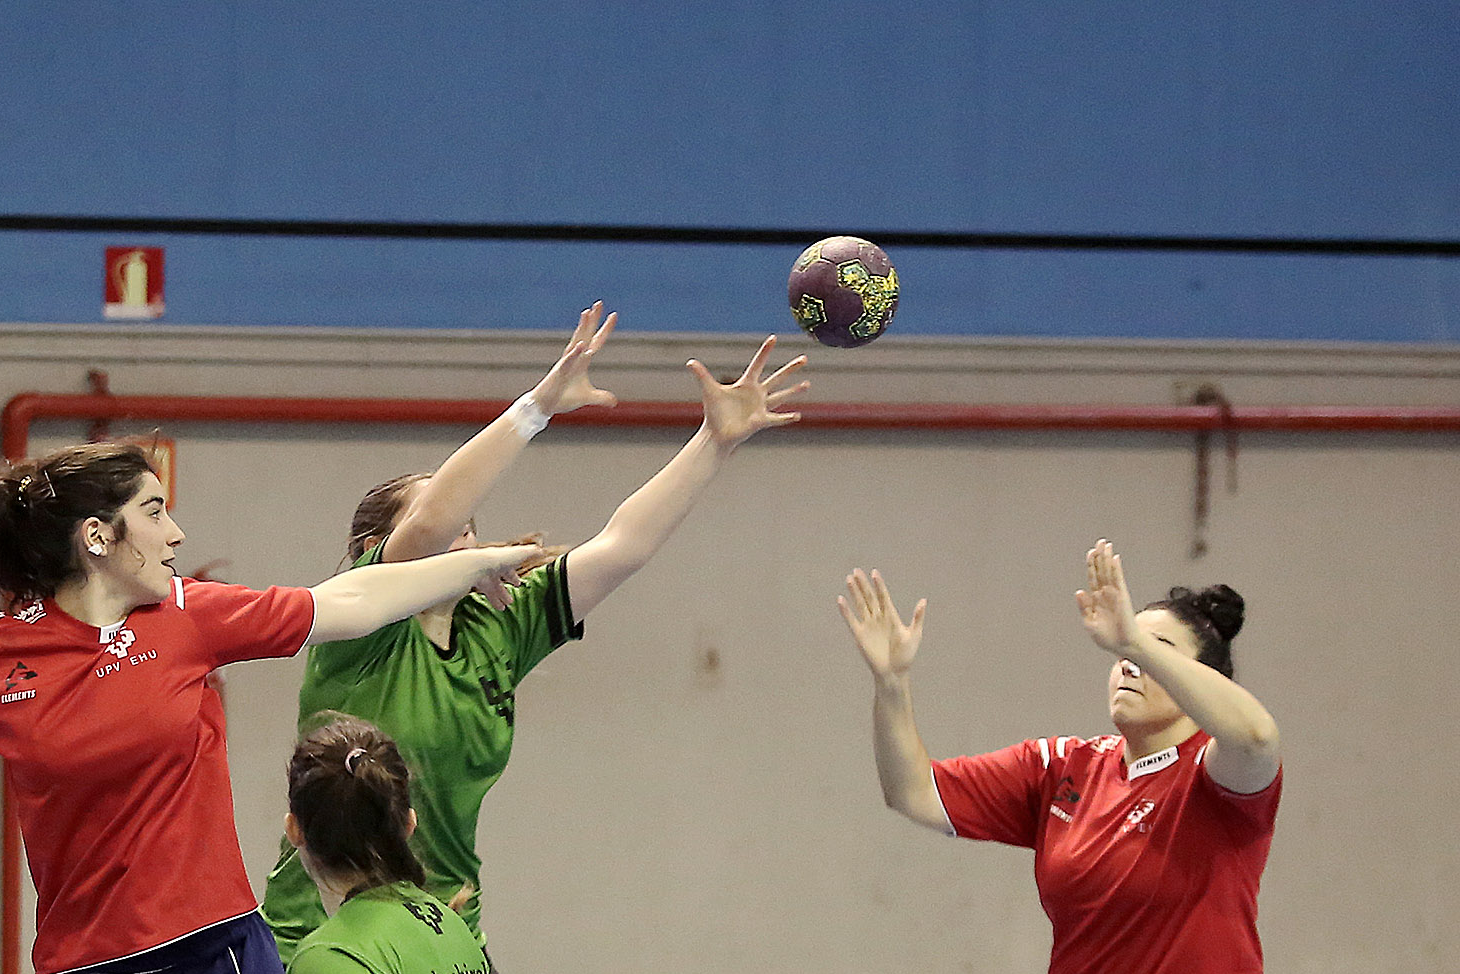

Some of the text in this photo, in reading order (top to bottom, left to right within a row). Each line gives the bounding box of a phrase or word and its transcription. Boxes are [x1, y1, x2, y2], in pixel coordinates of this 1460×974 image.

[95, 649, 157, 678] UPV EHU
[1, 689, 36, 704] ELEMENTS
